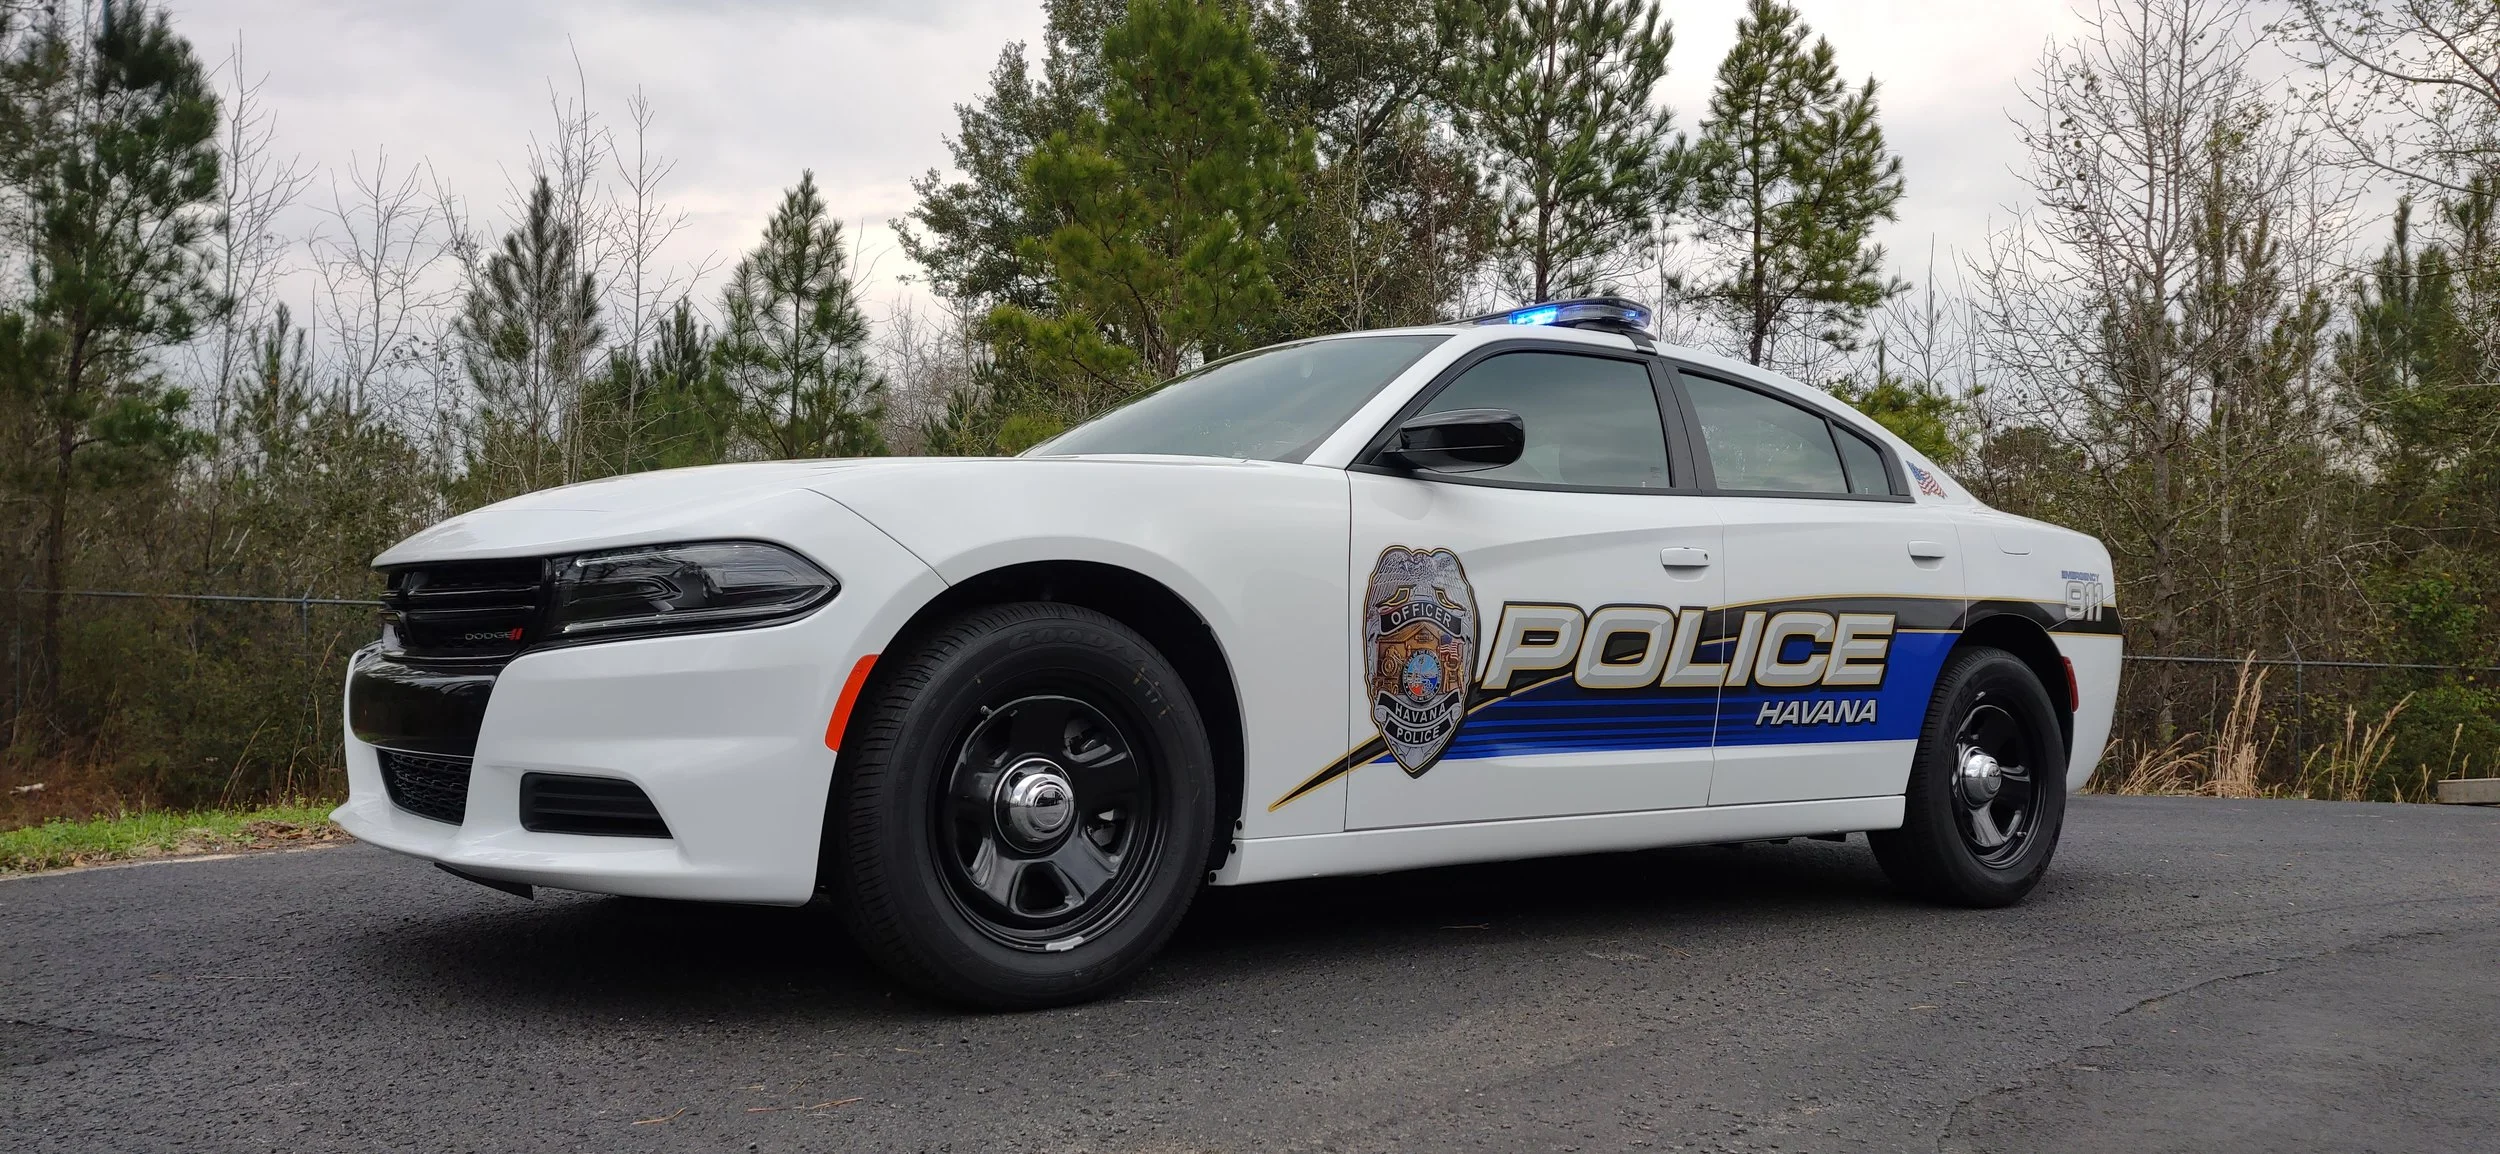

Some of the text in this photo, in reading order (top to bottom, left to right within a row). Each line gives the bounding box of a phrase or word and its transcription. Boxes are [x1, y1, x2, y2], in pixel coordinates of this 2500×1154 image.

[2065, 580, 2103, 622] 911
[1391, 603, 1452, 628] OFFICER
[465, 631, 512, 641] DODGE
[1480, 602, 1896, 690] POLICE
[1395, 703, 1447, 723] HAVANA
[1755, 699, 1877, 726] HAVANA
[1396, 725, 1440, 744] POLICE
